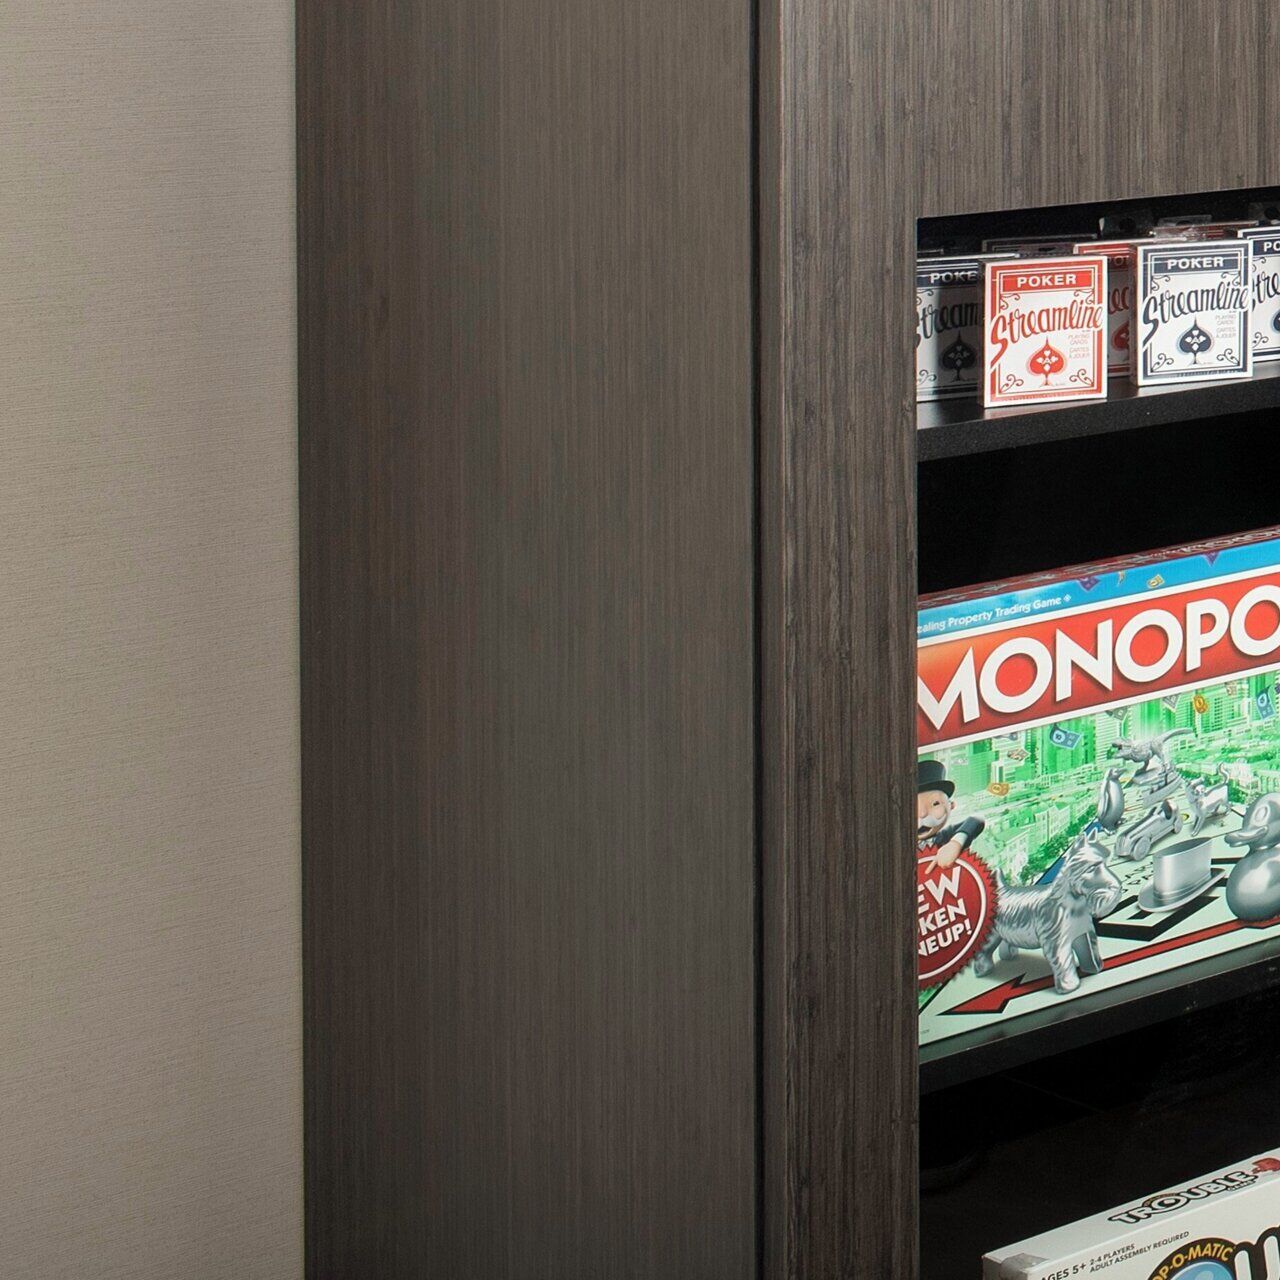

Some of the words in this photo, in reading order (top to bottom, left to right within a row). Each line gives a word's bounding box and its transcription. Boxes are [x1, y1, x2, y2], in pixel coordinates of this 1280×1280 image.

[1167, 256, 1224, 270] POKER
[1017, 273, 1077, 288] POKER
[1142, 280, 1249, 348] Streamline
[990, 298, 1103, 370] Streamline
[948, 610, 993, 627] Property
[995, 601, 1031, 618] Trading
[1032, 597, 1062, 610] Game
[1108, 1171, 1258, 1223] TROUBLE
[1089, 1259, 1114, 1273] ADULT
[1114, 1245, 1151, 1265] ASSEMBLY
[1152, 1231, 1190, 1249] REQUIRED
[1089, 1255, 1102, 1266] 2-4
[1103, 1243, 1135, 1260] PLAYERS
[1041, 1267, 1069, 1280] AGES
[1072, 1263, 1087, 1276] 5+
